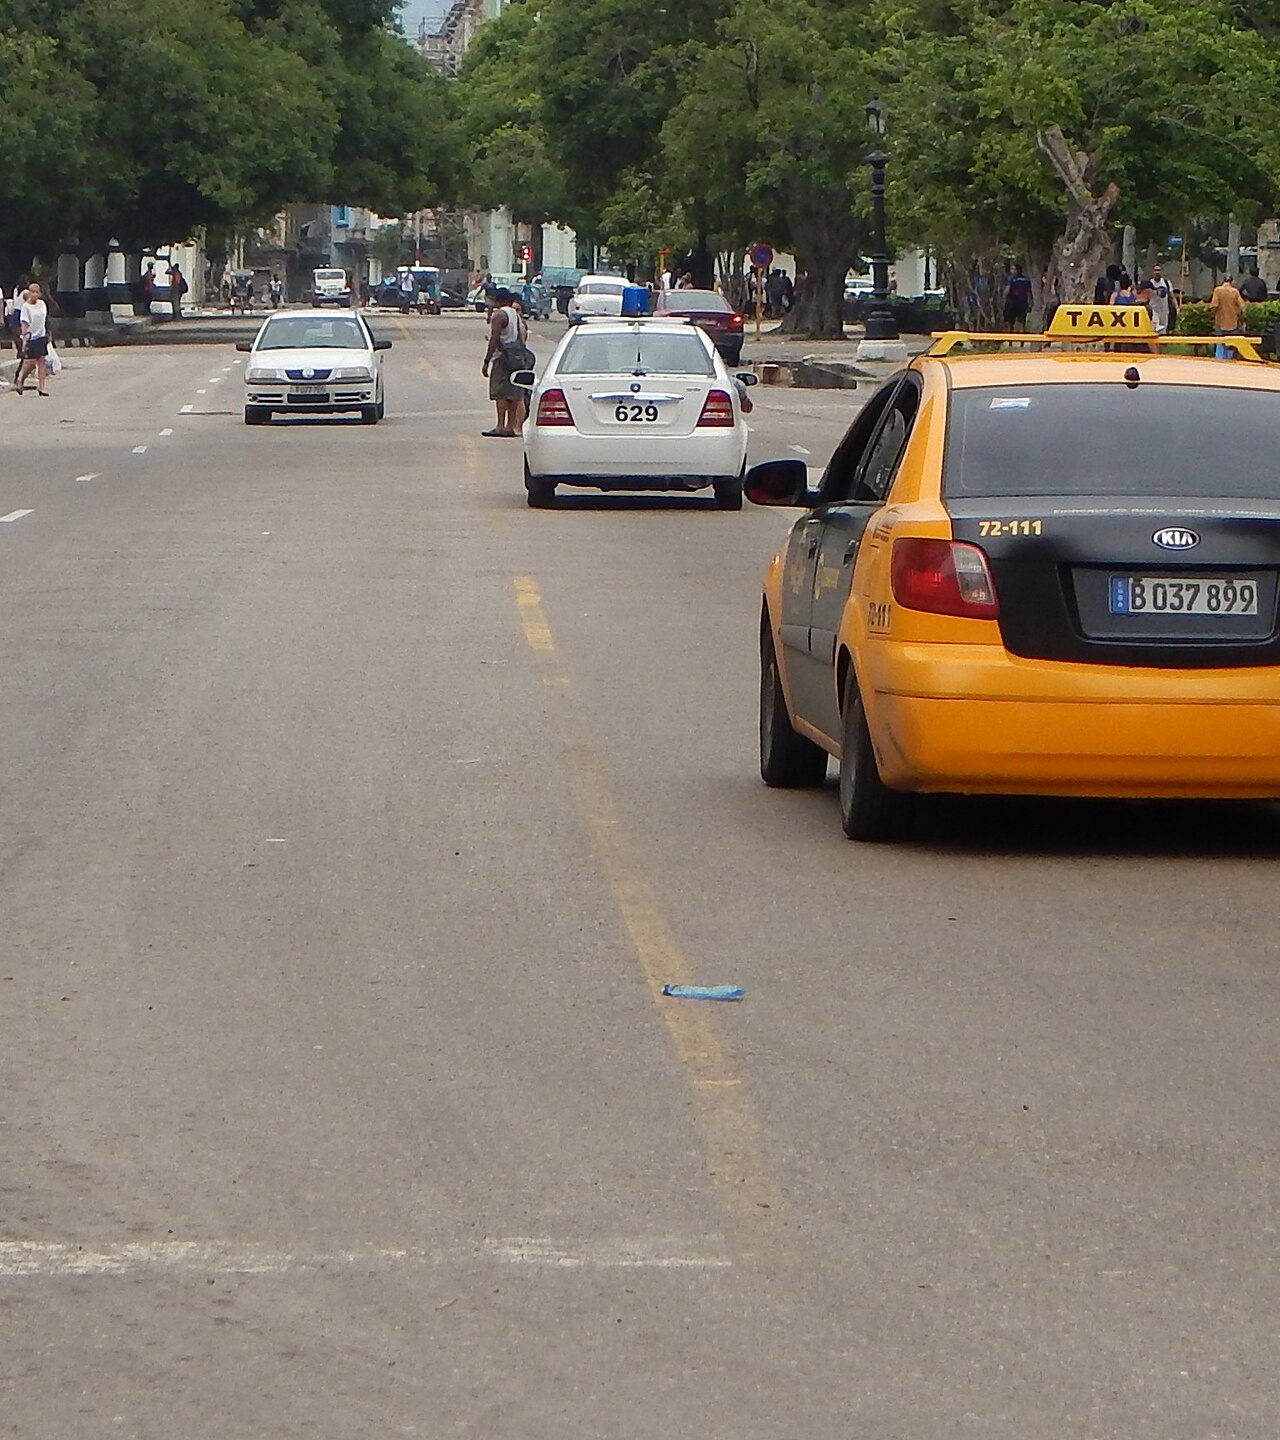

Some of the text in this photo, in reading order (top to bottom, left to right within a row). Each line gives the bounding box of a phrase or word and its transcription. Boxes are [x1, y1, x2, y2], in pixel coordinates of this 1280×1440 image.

[1066, 311, 1140, 328] TAXI
[615, 405, 658, 422] 629
[978, 520, 1042, 537] 72-111
[1161, 531, 1193, 545] KIA
[1131, 582, 1146, 610] B
[1152, 583, 1200, 611] 037
[1207, 585, 1254, 612] 899
